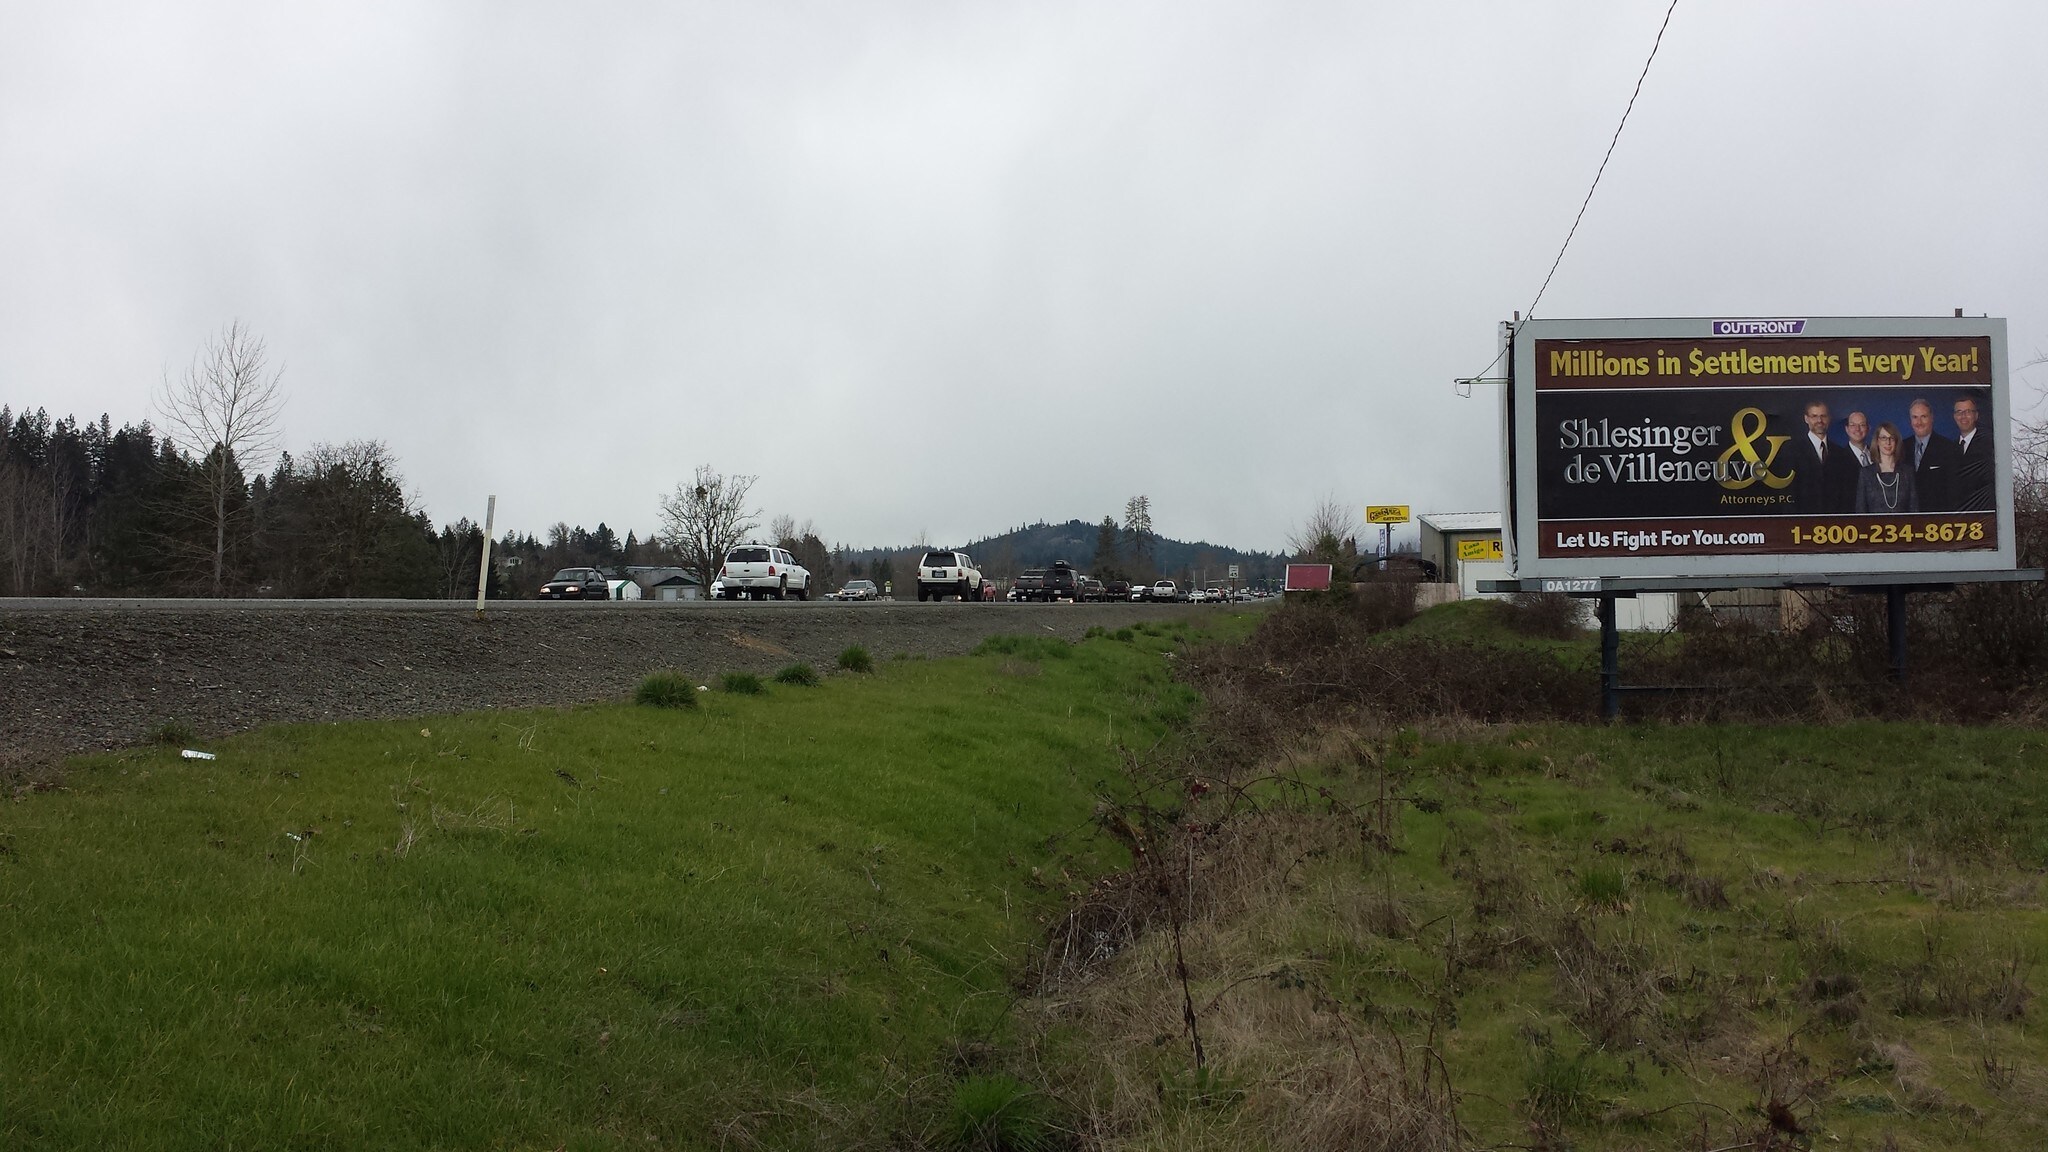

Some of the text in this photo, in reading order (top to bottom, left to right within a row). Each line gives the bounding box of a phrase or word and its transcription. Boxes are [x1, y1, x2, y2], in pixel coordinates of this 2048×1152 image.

[1720, 321, 1797, 334] OUTFRONT
[1550, 346, 1979, 381] Millions in $ettlements Every Year!
[1559, 417, 1722, 455] Shlesinger
[1717, 407, 1796, 490] &
[1720, 494, 1795, 506] Attorneys P.C.
[1557, 529, 1765, 551] Let Us Fight For You.com
[1791, 522, 1984, 544] 1-800-234-8678
